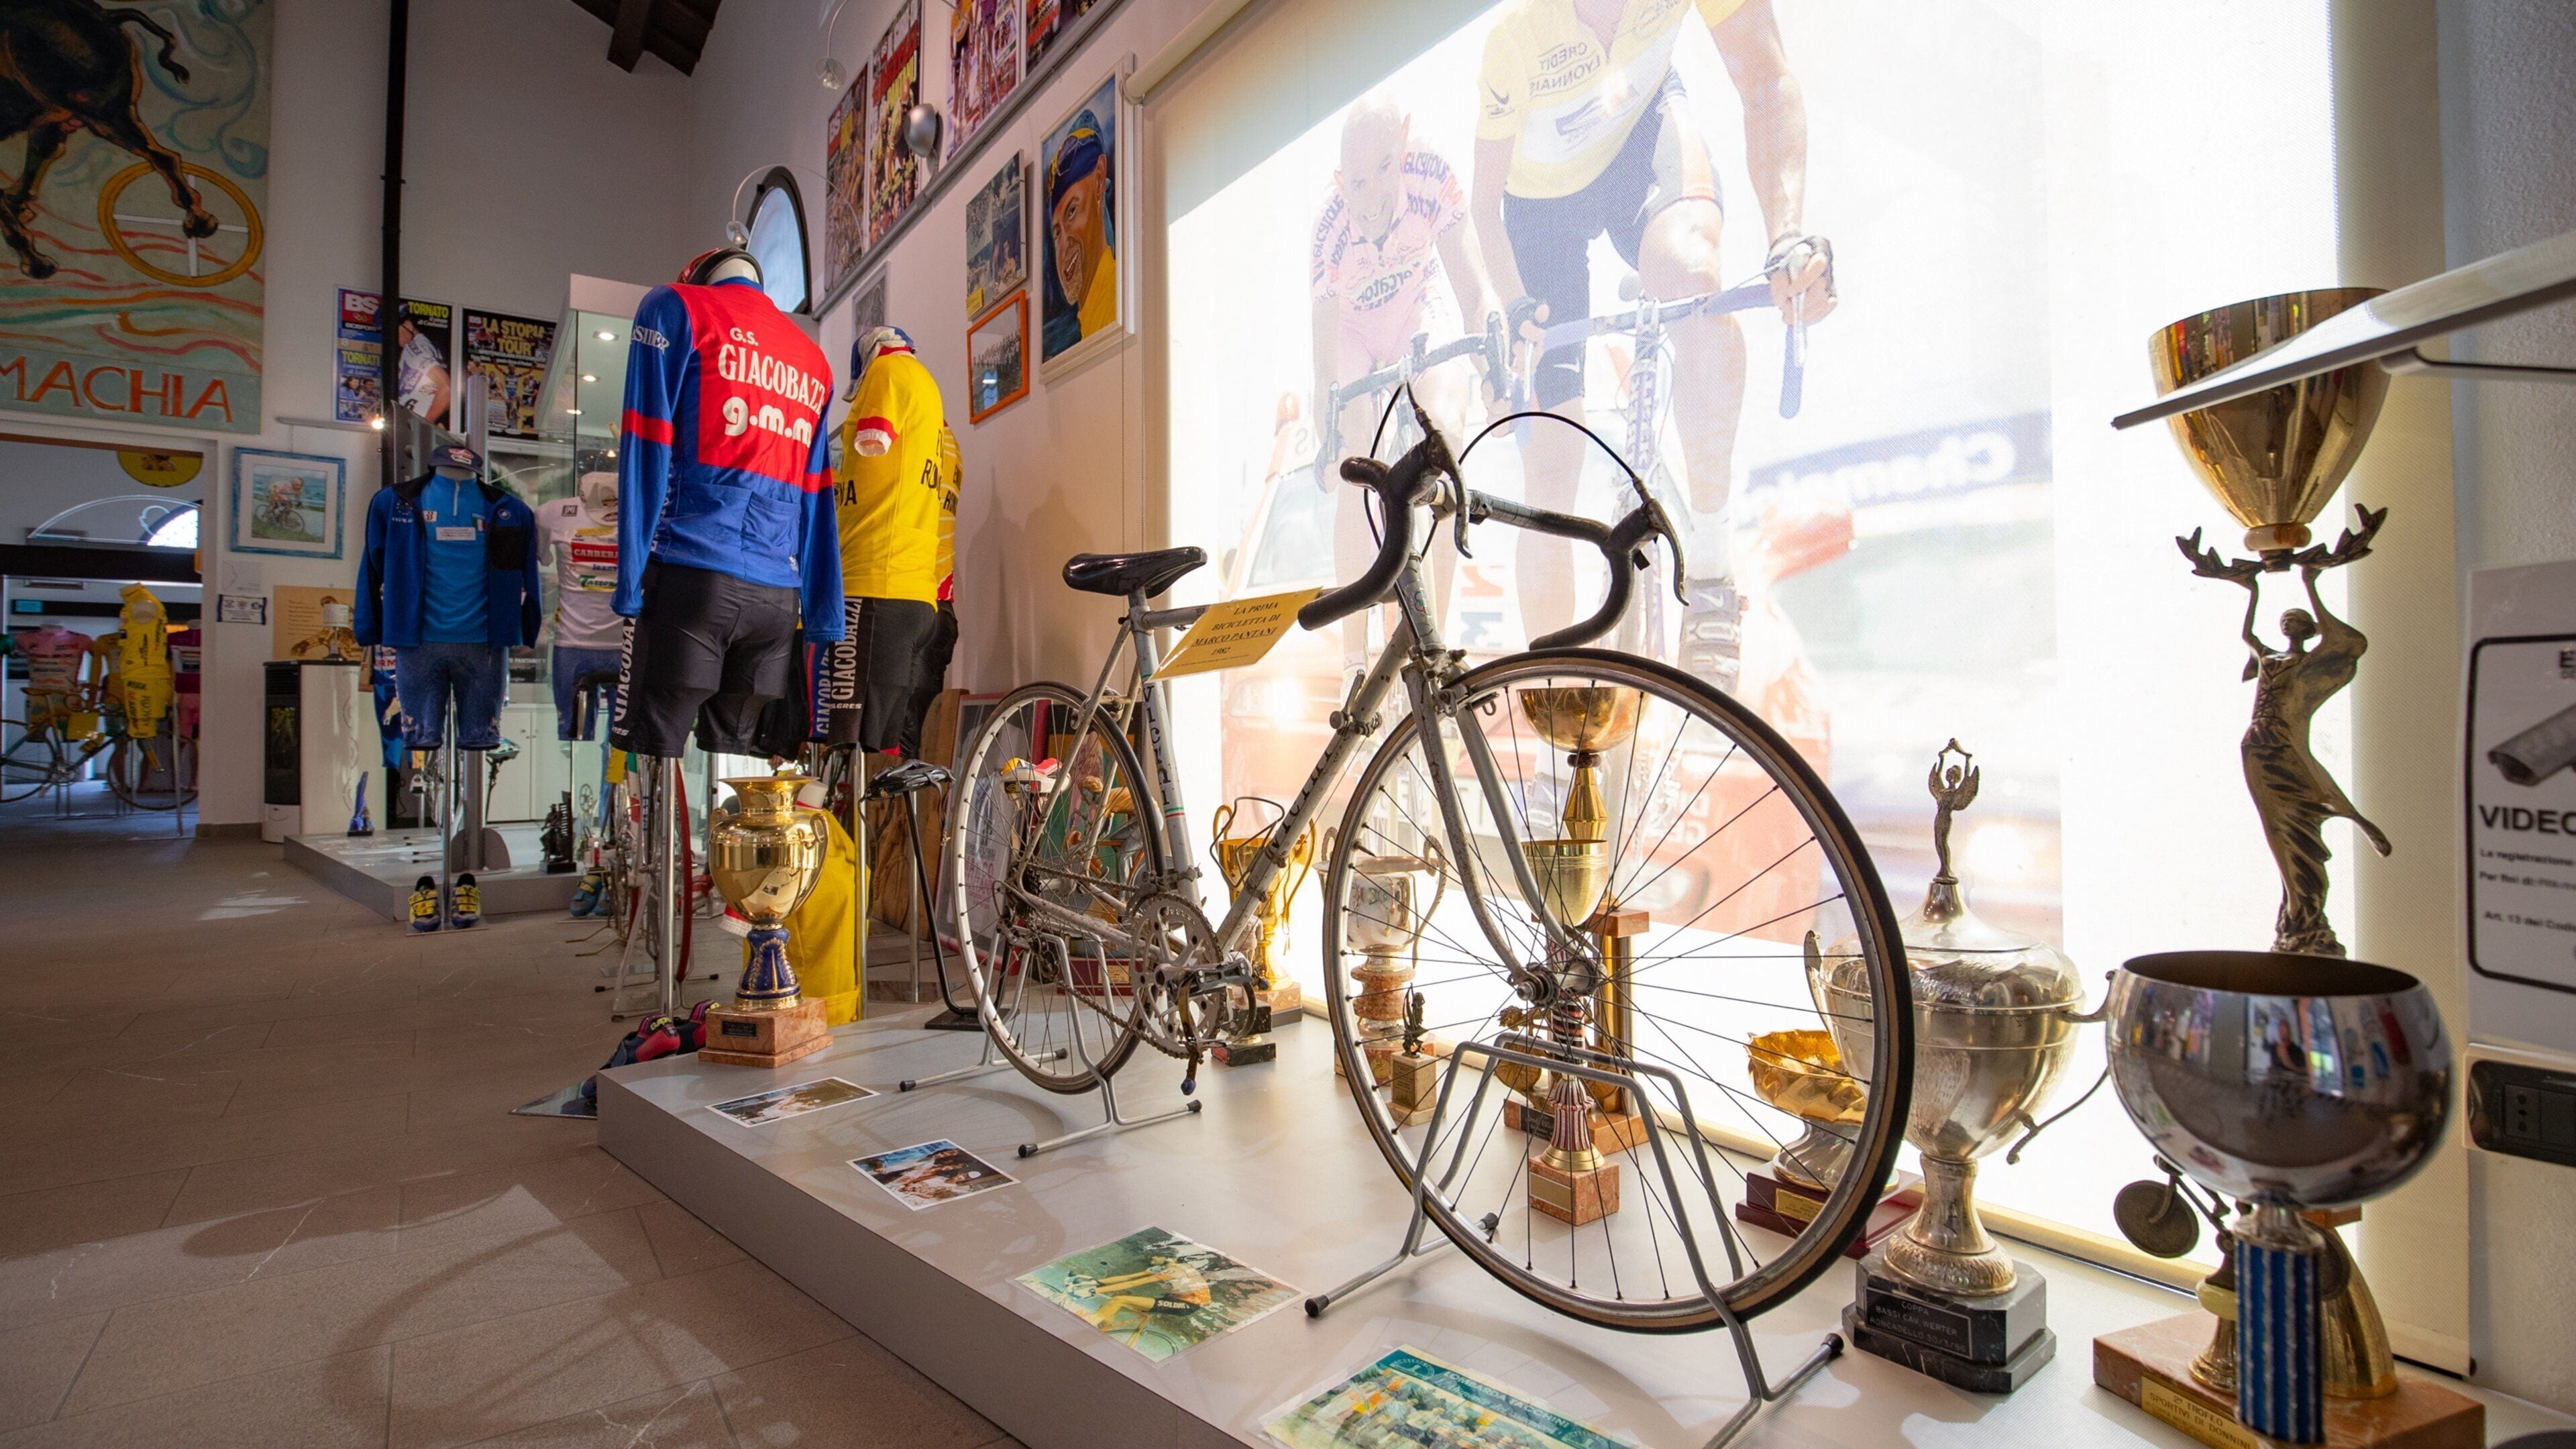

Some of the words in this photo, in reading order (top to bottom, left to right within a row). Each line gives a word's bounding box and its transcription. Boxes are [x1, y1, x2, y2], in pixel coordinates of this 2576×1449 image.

[408, 302, 449, 319] TORNATO
[730, 327, 759, 346] G.S.
[497, 337, 531, 356] TOUR
[718, 343, 826, 418] GIACOBAZZ
[1233, 606, 1247, 616] LA
[1247, 602, 1279, 614] PRIMA
[1212, 616, 1267, 631] BICICLETTA
[1269, 614, 1281, 622] DI
[1193, 632, 1231, 646] MARCO
[1230, 627, 1278, 641] PANTANI
[613, 616, 637, 723] GIACOBA
[2149, 1393, 2190, 1419] SPORTIVI
[2194, 1415, 2204, 1427] DI
[2187, 1403, 2224, 1427] TROFEO
